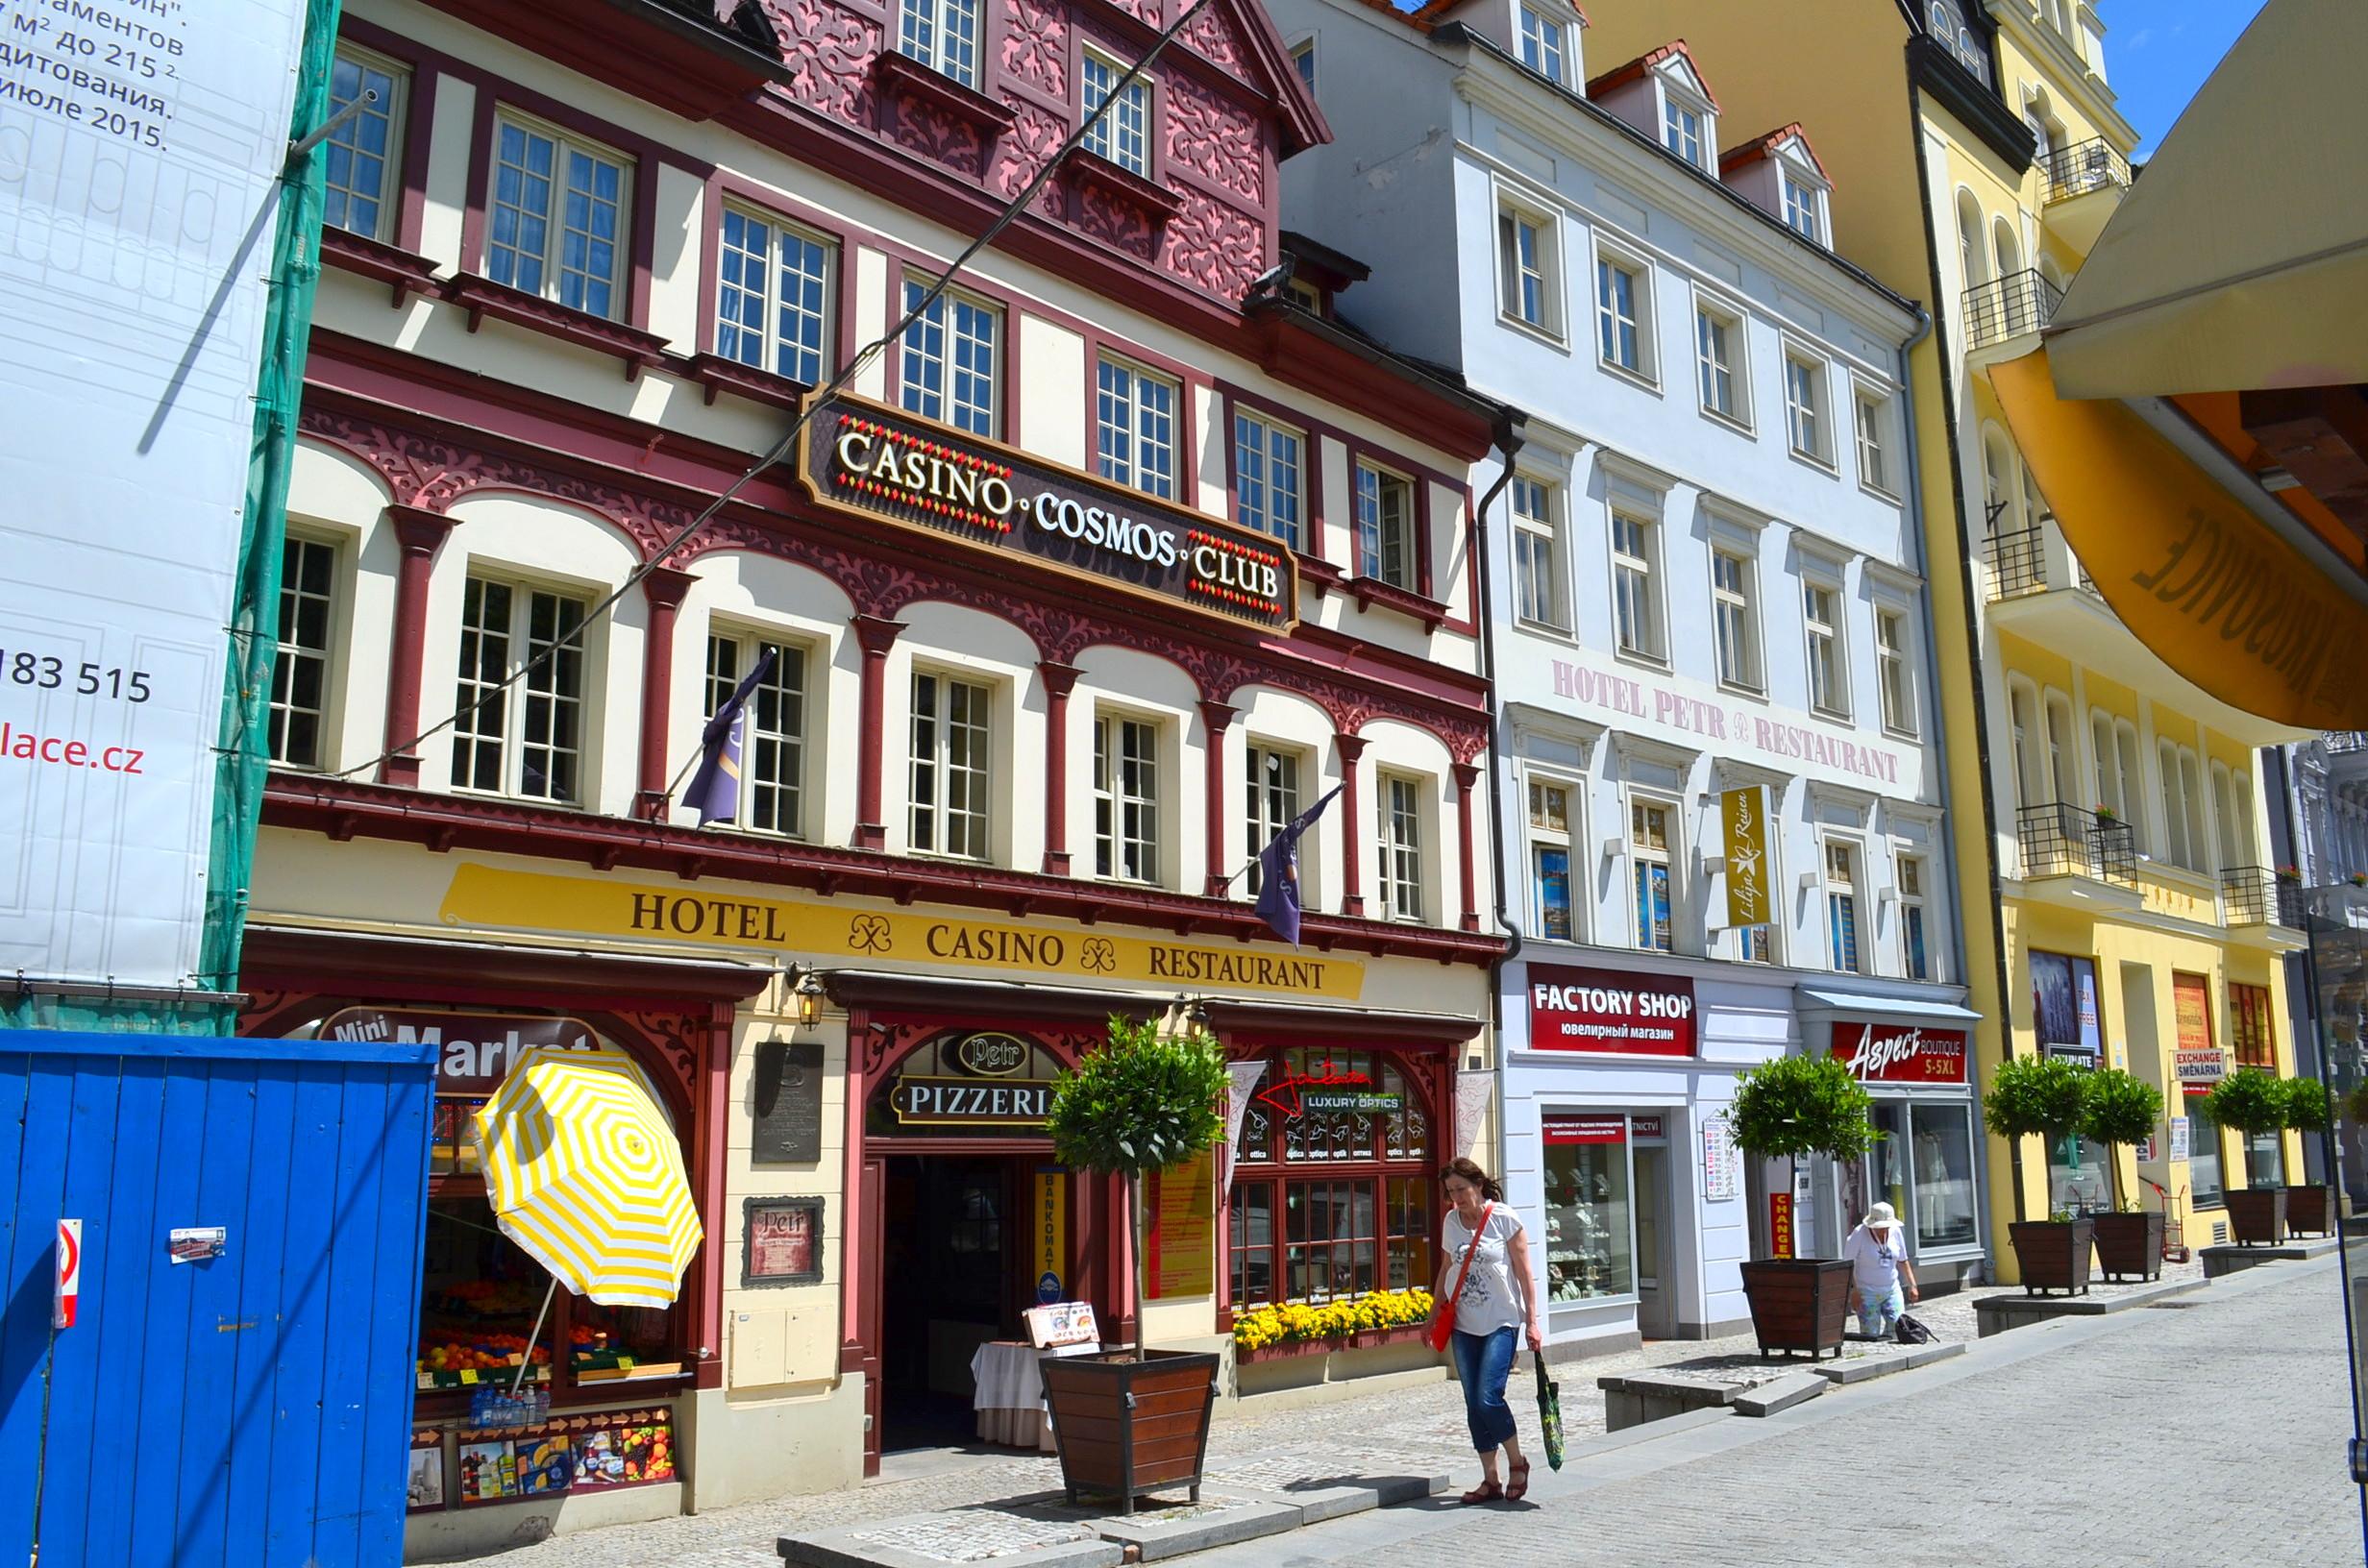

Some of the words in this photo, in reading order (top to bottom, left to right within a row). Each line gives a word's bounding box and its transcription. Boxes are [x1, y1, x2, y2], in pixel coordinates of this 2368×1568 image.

[15, 0, 185, 57] аментов
[56, 31, 96, 56] до
[105, 43, 157, 79] 215
[0, 77, 83, 121] июле
[91, 107, 167, 152] 2015.
[838, 432, 1013, 516] CASINO
[1035, 491, 1176, 569] COSMOS
[1194, 545, 1279, 599] CLUB
[0, 649, 63, 690] 83
[77, 662, 151, 703] 515
[1551, 659, 1646, 719] HOTEL
[1654, 688, 1727, 741] PETR
[1754, 716, 1898, 784] RESTAURANT
[1, 722, 145, 775] lace.cz
[1735, 792, 1753, 839] Reisen
[630, 893, 786, 943] HOTEL
[925, 924, 1065, 967] CASINO
[1148, 946, 1325, 990] RESTAURANT
[1535, 983, 1633, 1016] FACTORY
[1640, 992, 1692, 1019] SHOP
[334, 1015, 389, 1043] Mini
[396, 1025, 590, 1078] Mark
[971, 1038, 1020, 1067] Petr
[1561, 1021, 1629, 1041] ювелирный
[1630, 1027, 1674, 1041] магазин
[1846, 1023, 1922, 1082] Aspect
[1920, 1039, 1961, 1057] BOUTIQUE
[1925, 1059, 1956, 1075] S-5XL
[2176, 1052, 2221, 1065] EXCHANGE
[2178, 1063, 2222, 1077] SMĚNÁRNA
[908, 1086, 1057, 1116] PIZZERI
[1308, 1096, 1356, 1108] LUXURY
[1359, 1097, 1399, 1109] OPTICS
[1045, 1174, 1054, 1270] BANKOMAT
[1776, 1194, 1788, 1255] CHANGE
